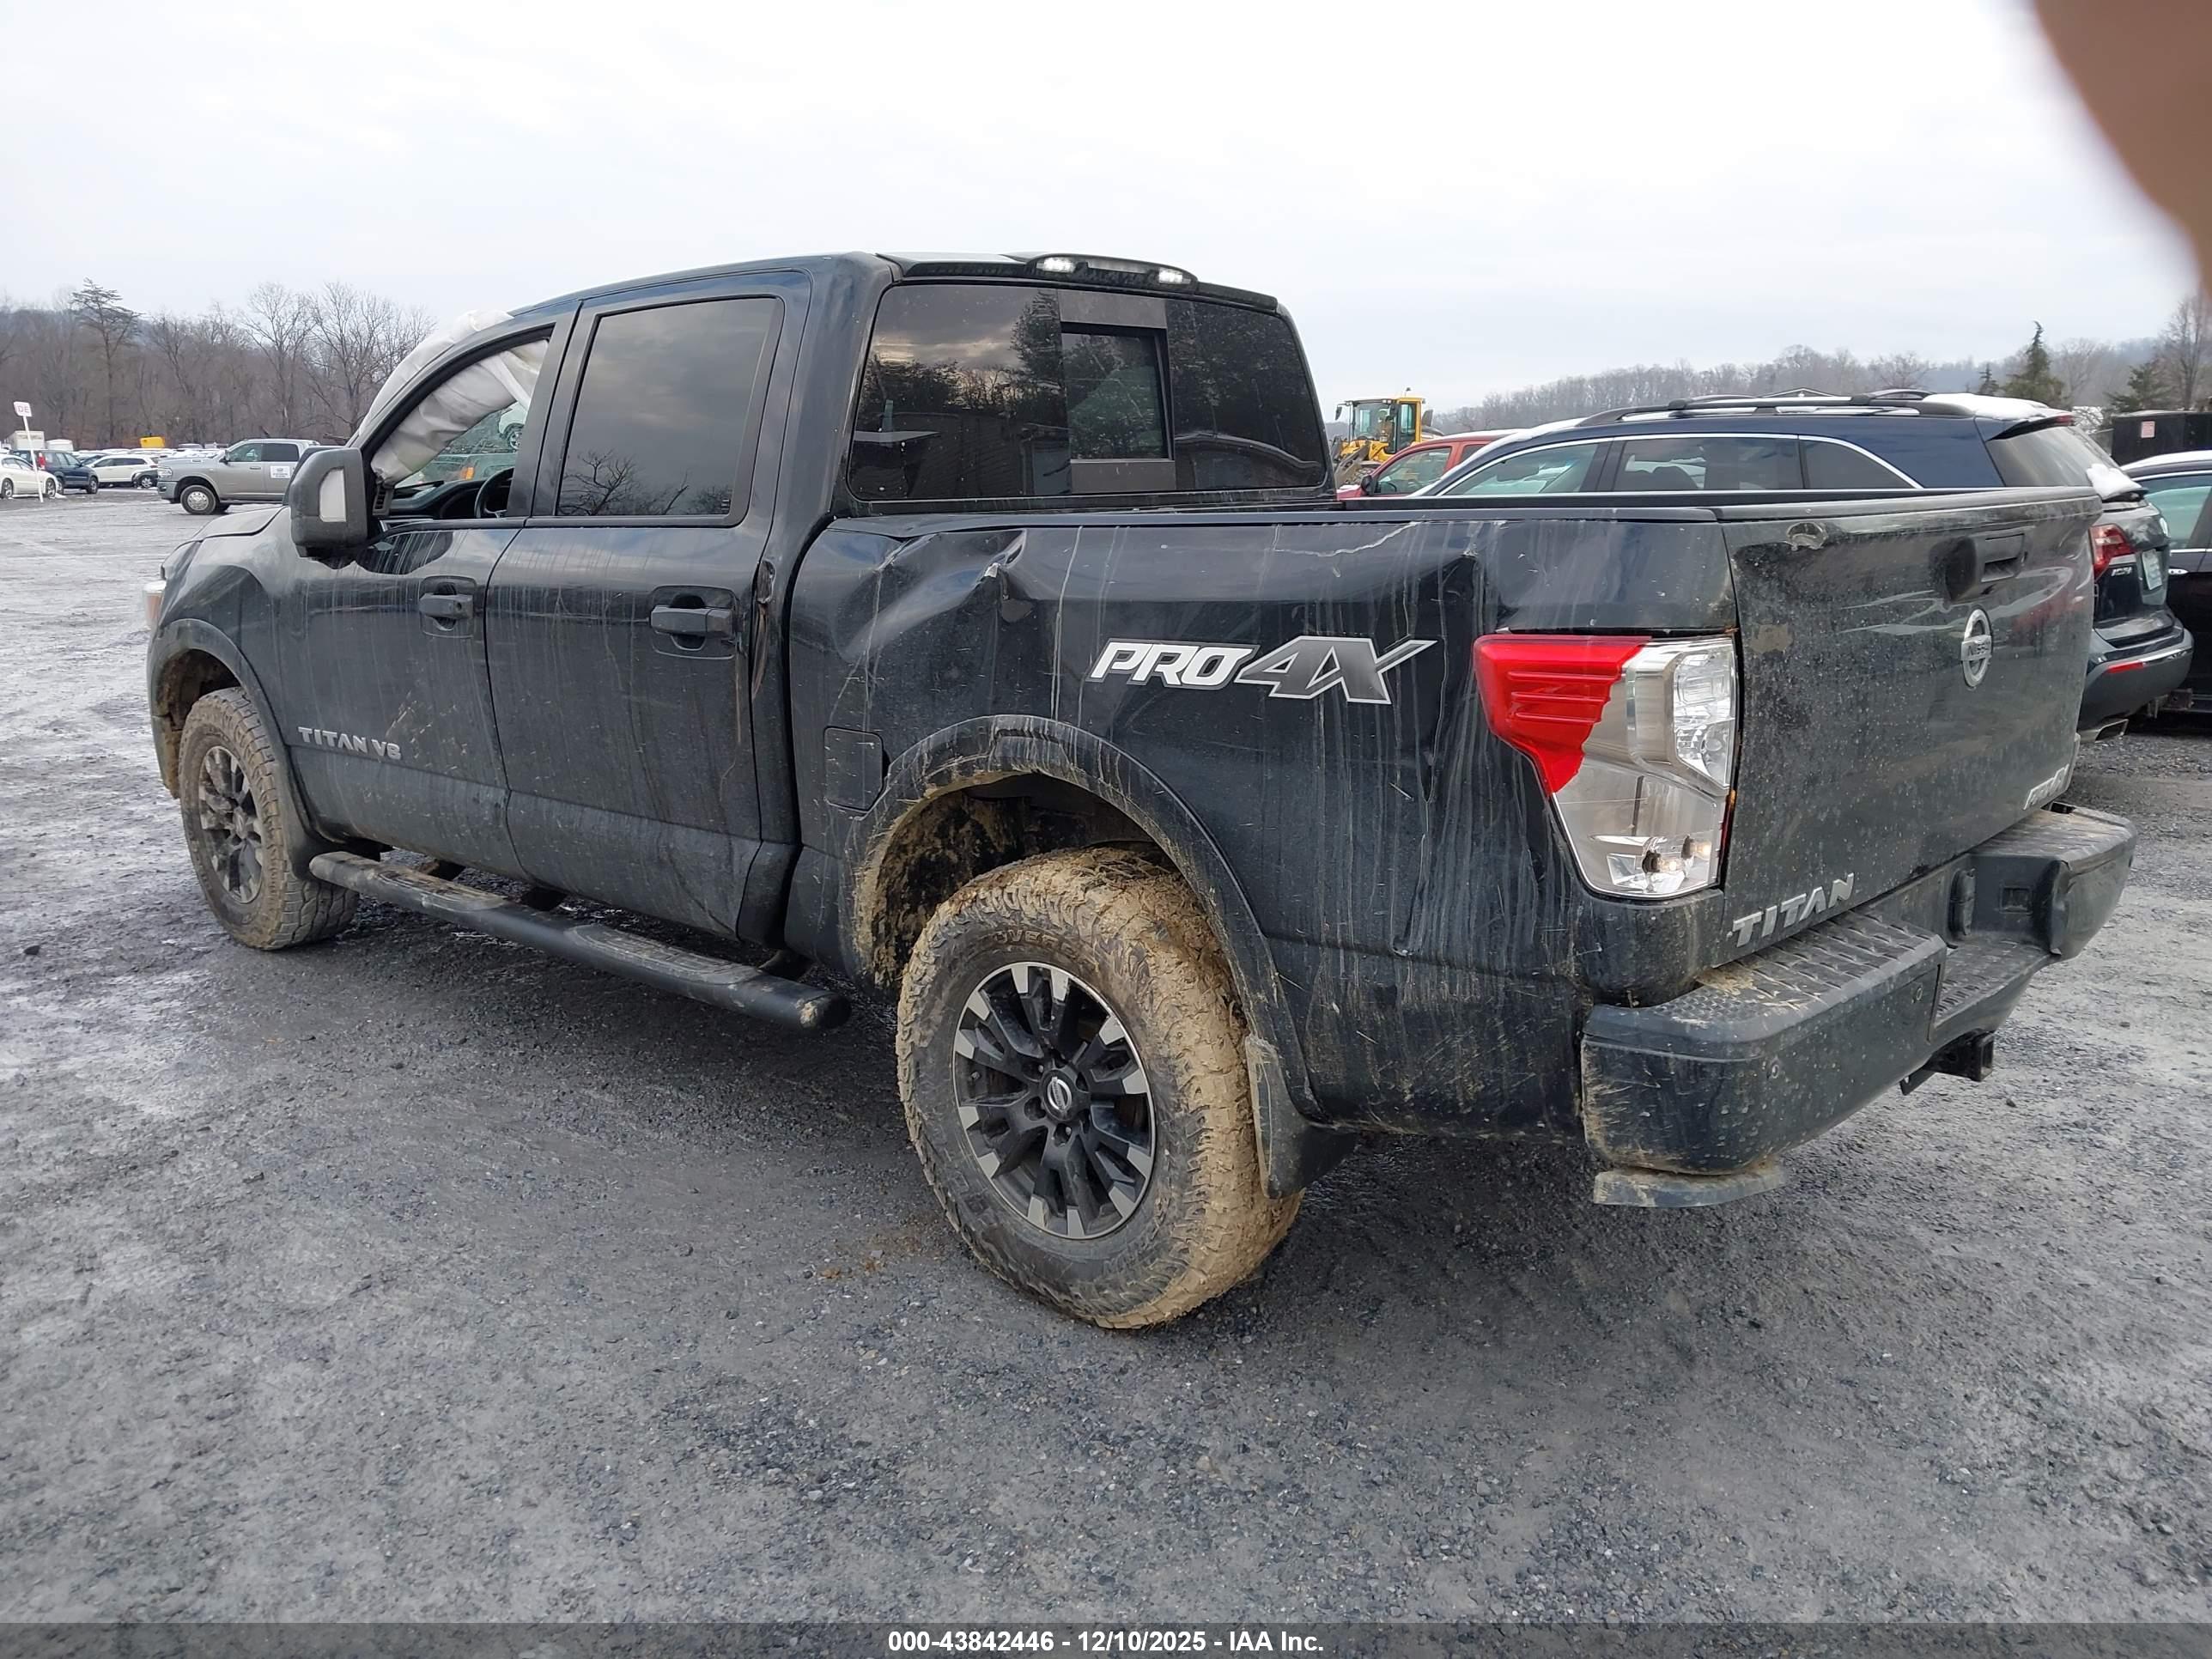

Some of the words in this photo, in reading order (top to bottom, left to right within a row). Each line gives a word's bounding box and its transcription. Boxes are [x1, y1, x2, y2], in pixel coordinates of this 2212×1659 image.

[298, 726, 368, 753] TITAN
[371, 738, 402, 760] V8
[1732, 872, 1855, 948] TITAN
